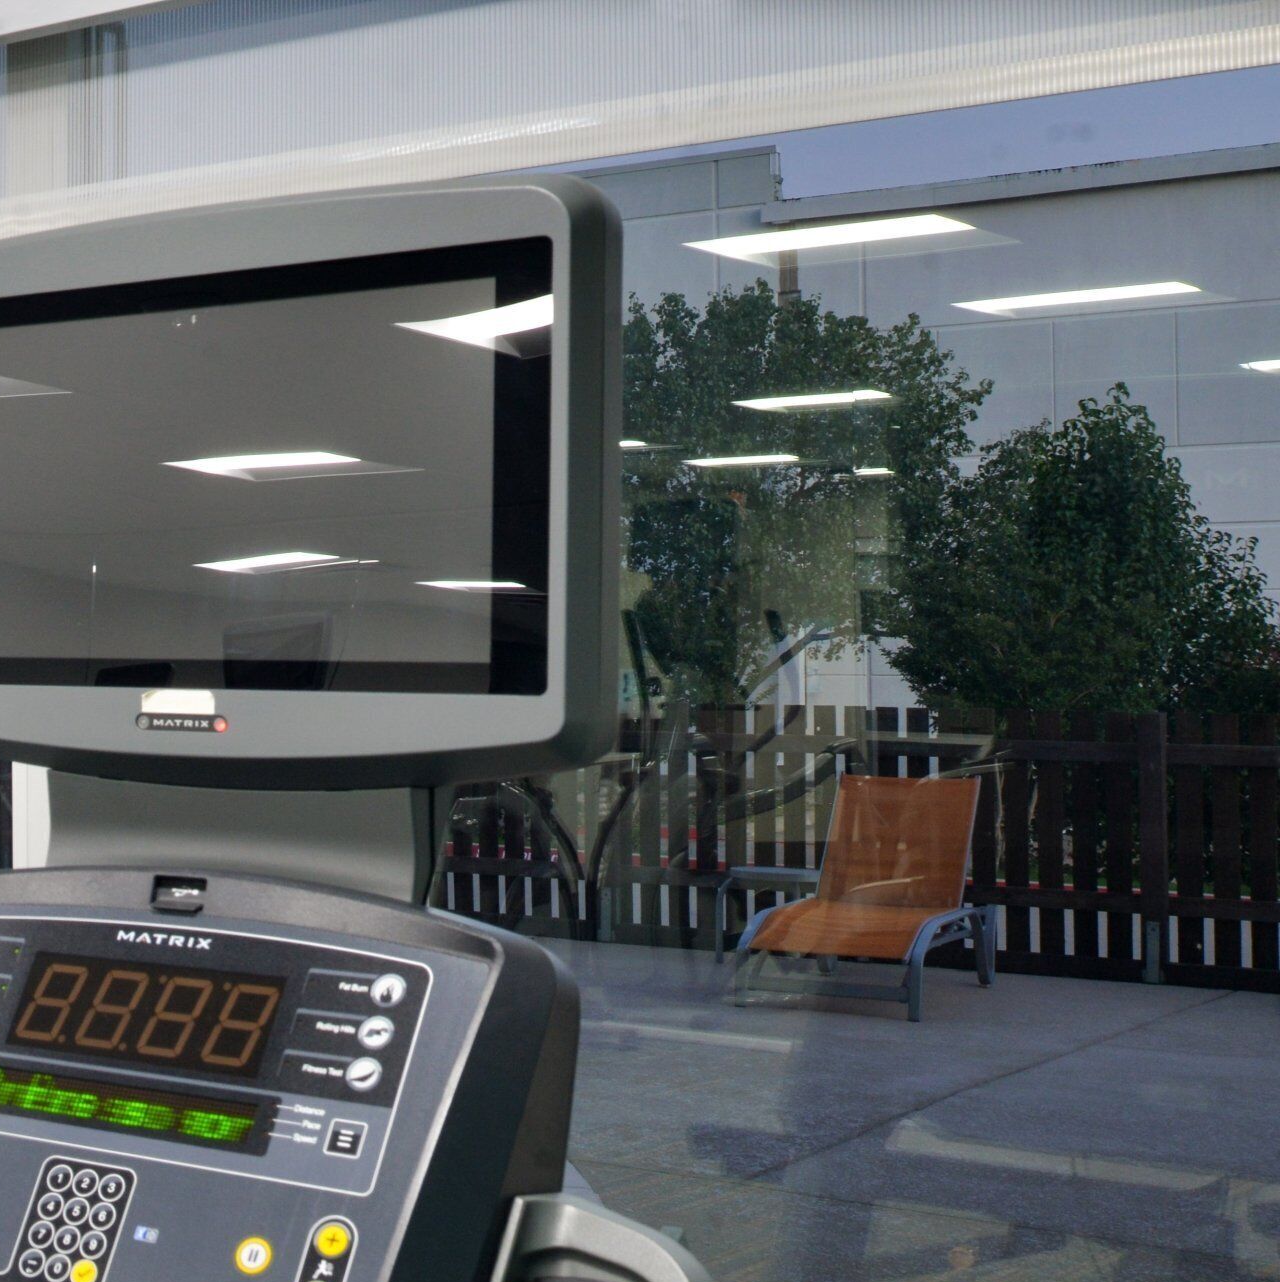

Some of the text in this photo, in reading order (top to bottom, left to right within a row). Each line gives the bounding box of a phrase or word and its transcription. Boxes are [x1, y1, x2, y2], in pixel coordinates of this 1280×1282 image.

[152, 719, 209, 728] MATRIX
[117, 929, 213, 950] MATRIX
[57, 1173, 116, 1194] 1 2 3
[47, 1201, 107, 1222] 4 5 6
[38, 1229, 98, 1251] 7 8 9
[54, 1262, 62, 1274] 0
